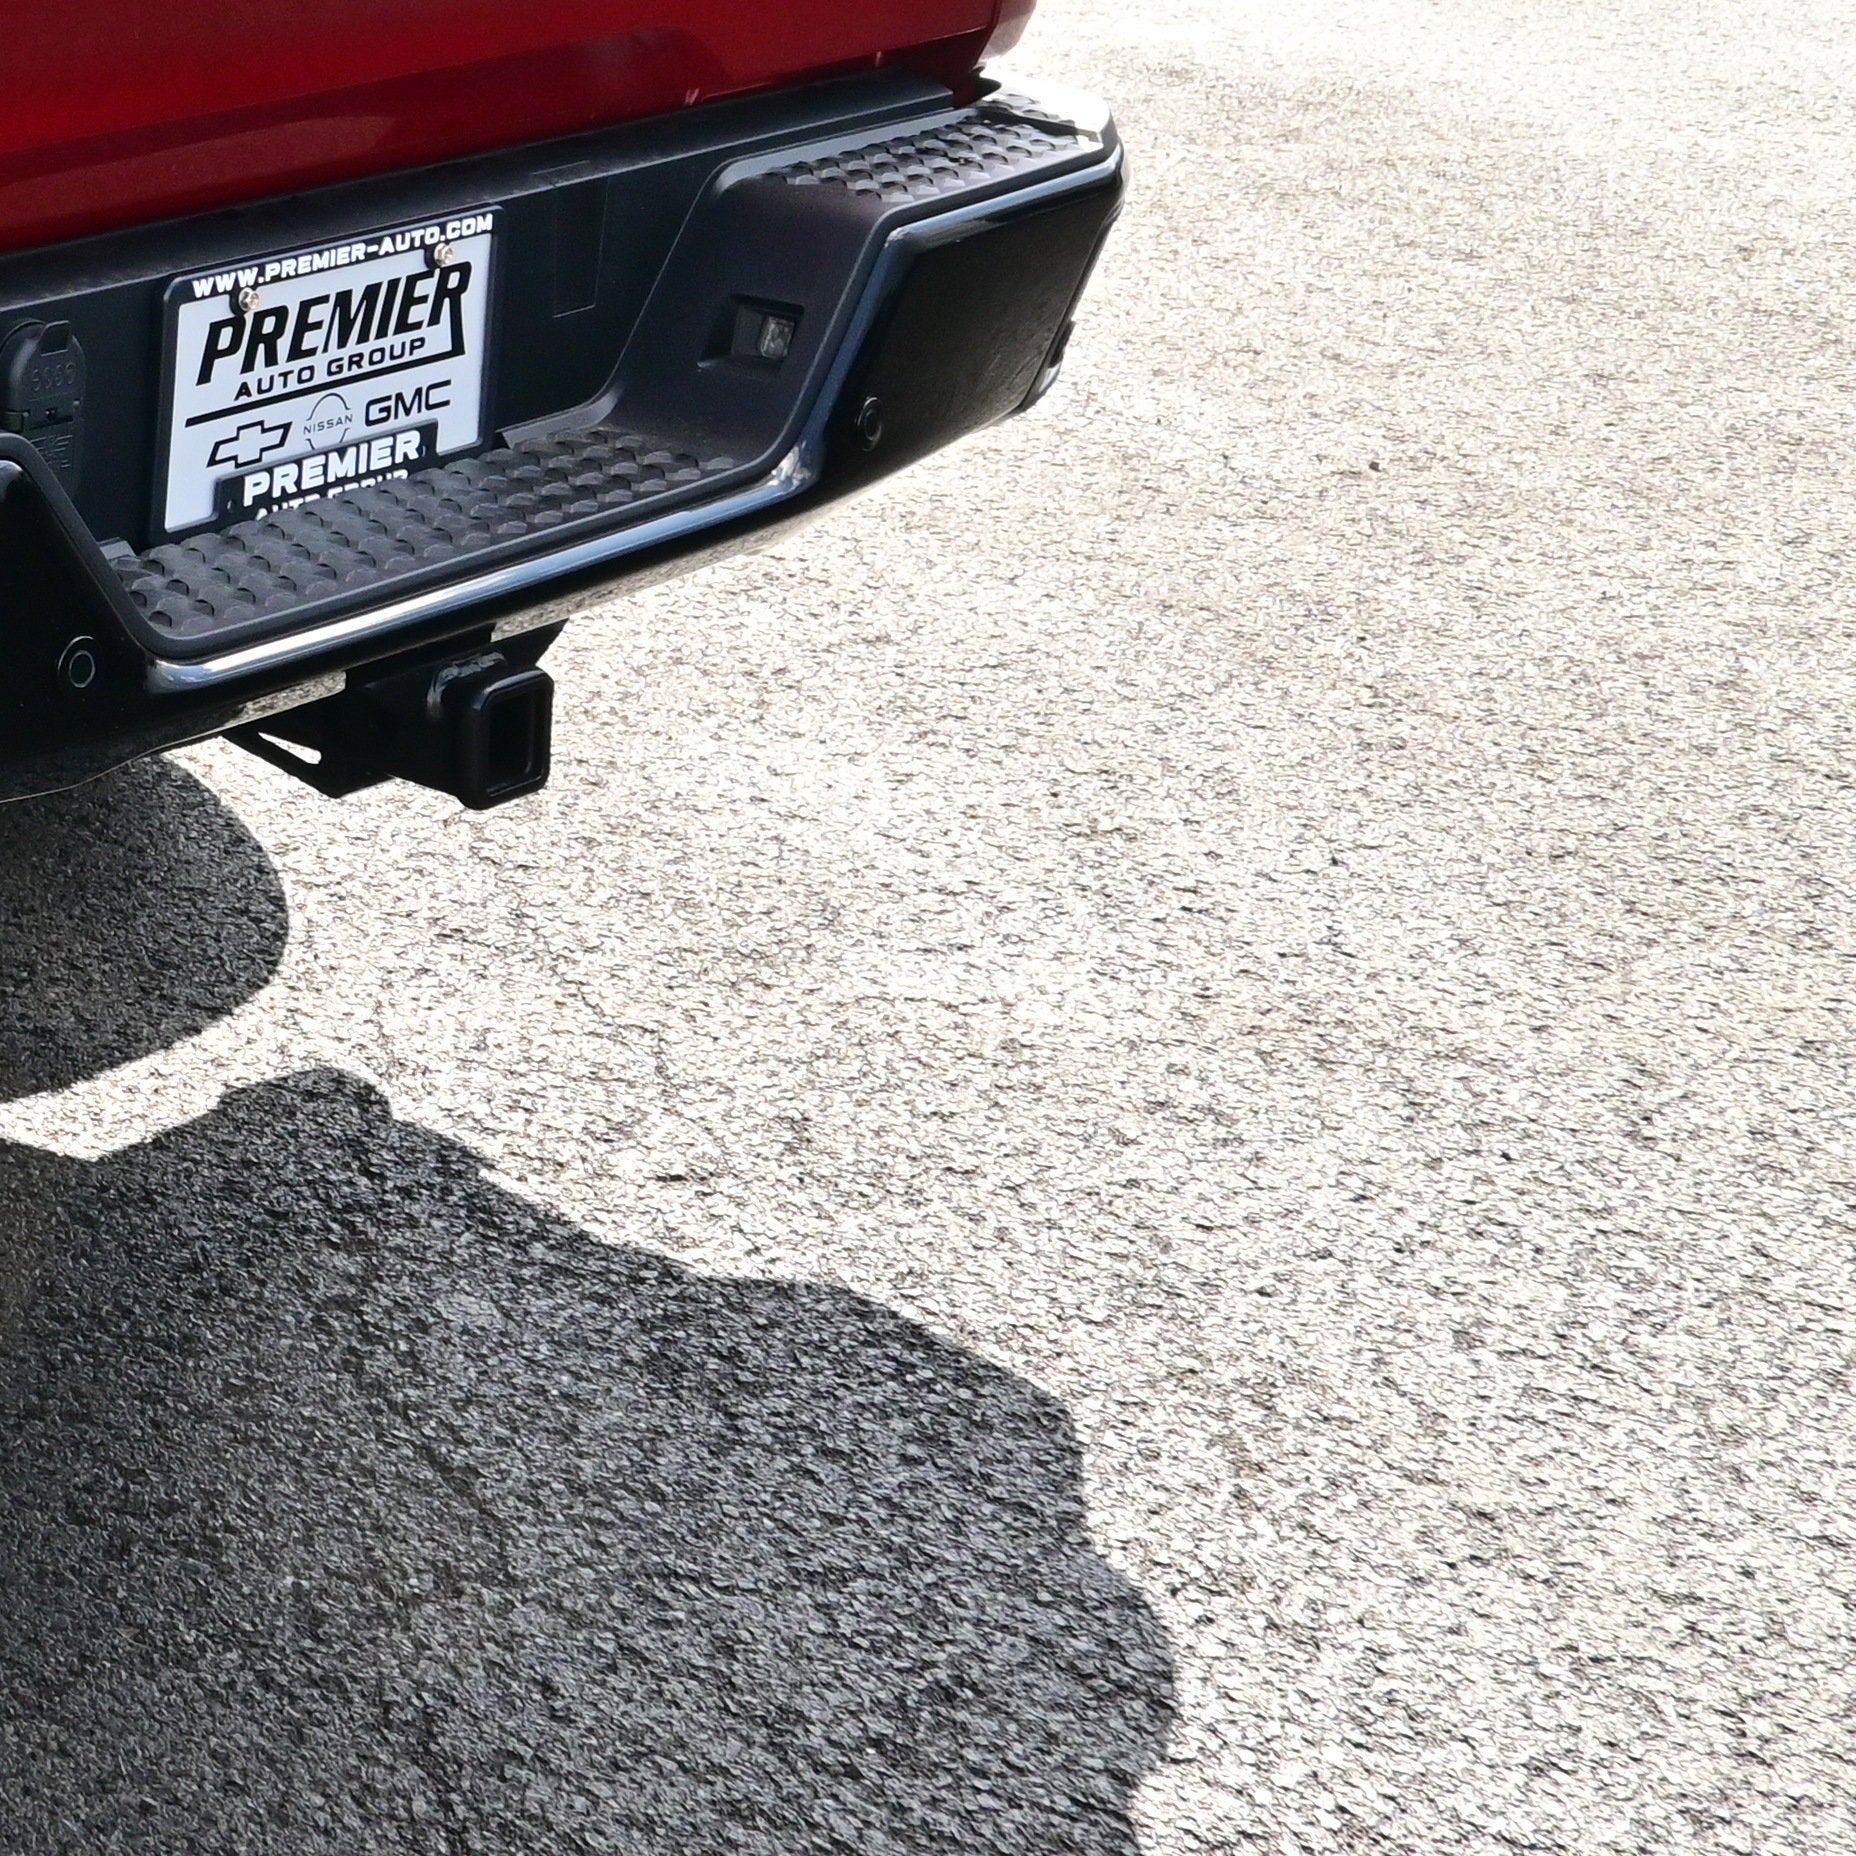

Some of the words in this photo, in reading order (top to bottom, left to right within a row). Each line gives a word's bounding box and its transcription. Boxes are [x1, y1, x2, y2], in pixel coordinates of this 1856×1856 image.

[192, 213, 493, 298] WWW.PREMIER-AUTO.COM
[195, 260, 473, 387] PREMIER
[234, 365, 315, 401] AUTO
[326, 336, 426, 377] GROUP
[364, 379, 452, 428] GMC
[303, 413, 354, 434] NISSAN
[243, 430, 421, 507] PREMIER
